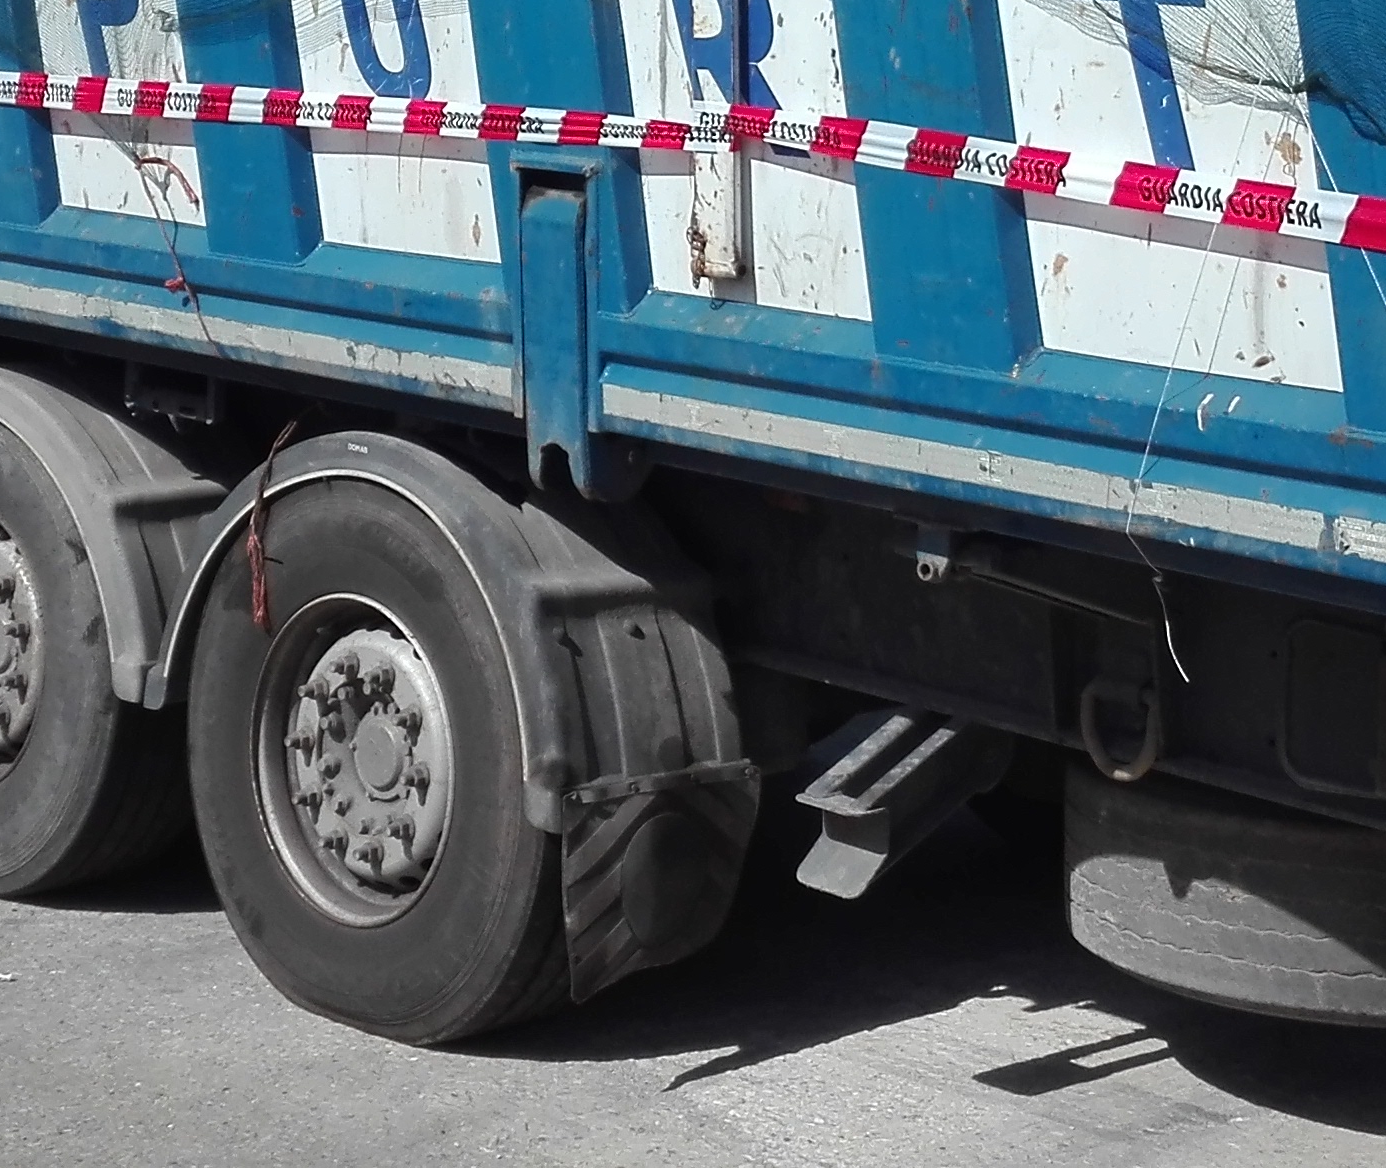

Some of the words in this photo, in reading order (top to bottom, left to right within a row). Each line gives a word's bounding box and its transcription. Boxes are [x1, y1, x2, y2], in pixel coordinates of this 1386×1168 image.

[985, 151, 1066, 187] COSTIERA
[1137, 176, 1225, 213] GUARDIA
[1227, 190, 1323, 230] COSTIERA
